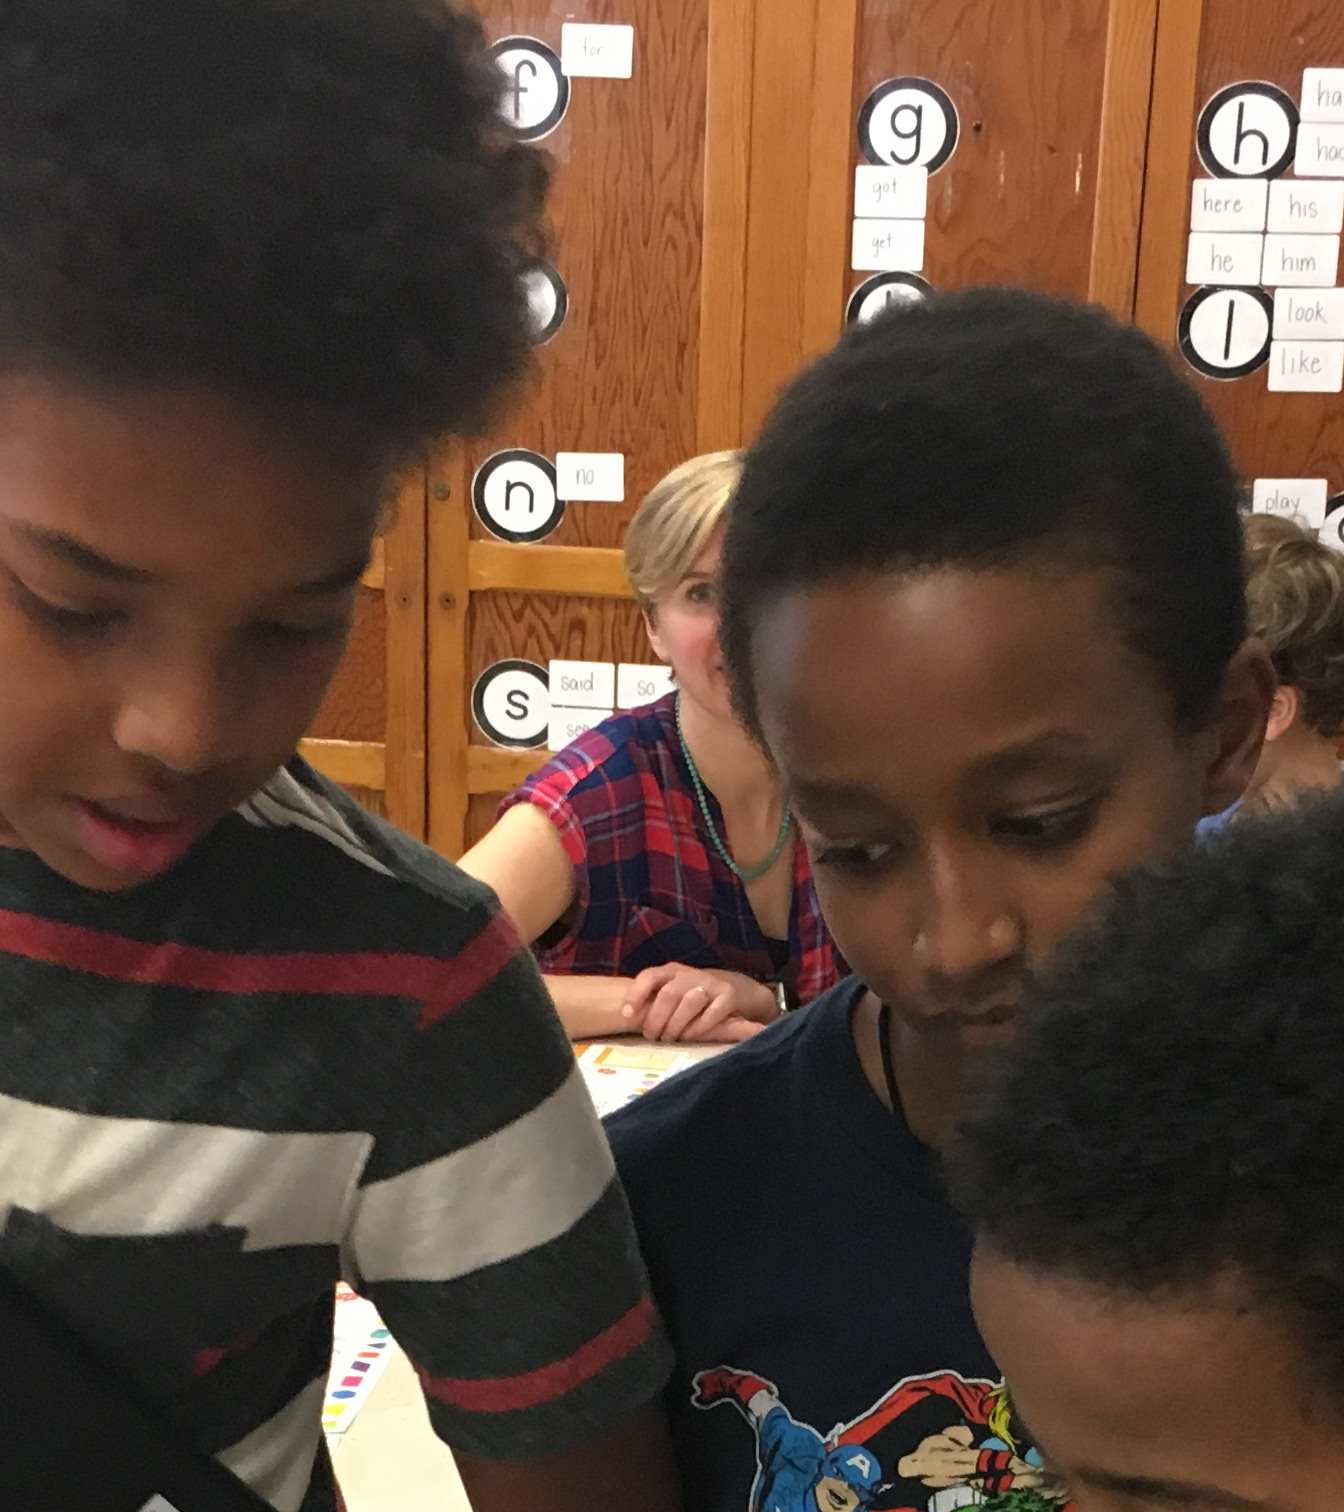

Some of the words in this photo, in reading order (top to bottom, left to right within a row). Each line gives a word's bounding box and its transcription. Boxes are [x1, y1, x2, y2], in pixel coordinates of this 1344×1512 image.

[509, 59, 537, 121] f
[890, 104, 923, 165] g
[1232, 101, 1269, 166] h
[872, 177, 899, 203] got
[1203, 187, 1244, 214] here
[1289, 192, 1319, 219] his
[871, 233, 895, 258] get
[1210, 243, 1234, 273] he
[1281, 247, 1316, 273] him
[1287, 297, 1328, 325] look
[1280, 347, 1323, 377] like
[574, 467, 595, 487] no
[504, 478, 535, 515] n
[1265, 489, 1301, 517] play
[560, 671, 594, 692] said
[504, 689, 530, 721] s
